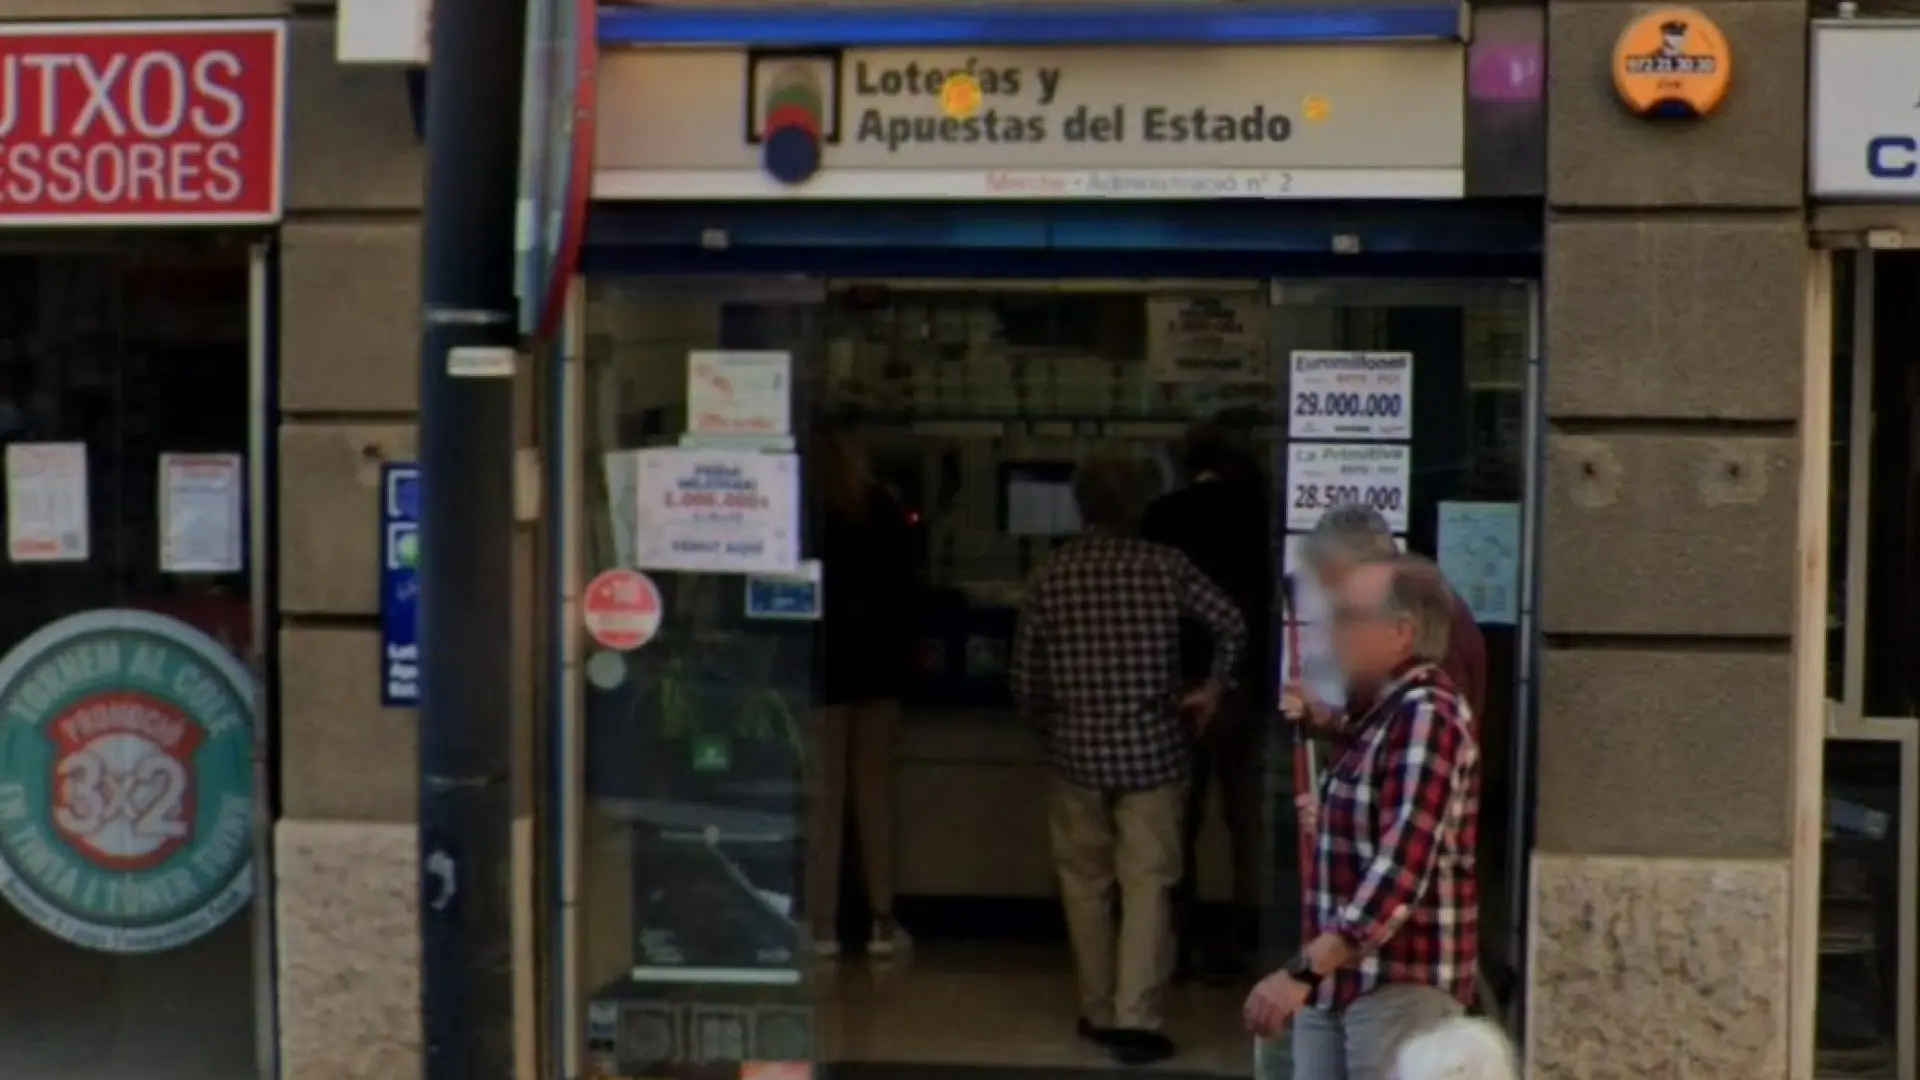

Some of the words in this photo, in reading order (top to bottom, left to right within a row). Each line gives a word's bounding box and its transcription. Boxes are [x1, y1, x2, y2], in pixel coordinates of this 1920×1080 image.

[856, 57, 1020, 97] Loteas
[1038, 68, 1060, 105] y
[857, 107, 1047, 153] Apuestas
[1065, 104, 1125, 142] del
[1143, 104, 1293, 142] Estado
[0, 142, 242, 203] SSORES
[1279, 172, 1295, 192] 2
[1294, 391, 1403, 417] 29.000.000
[1294, 484, 1402, 510] 28.500.000
[128, 643, 166, 682] AL
[56, 752, 188, 838] 3x2
